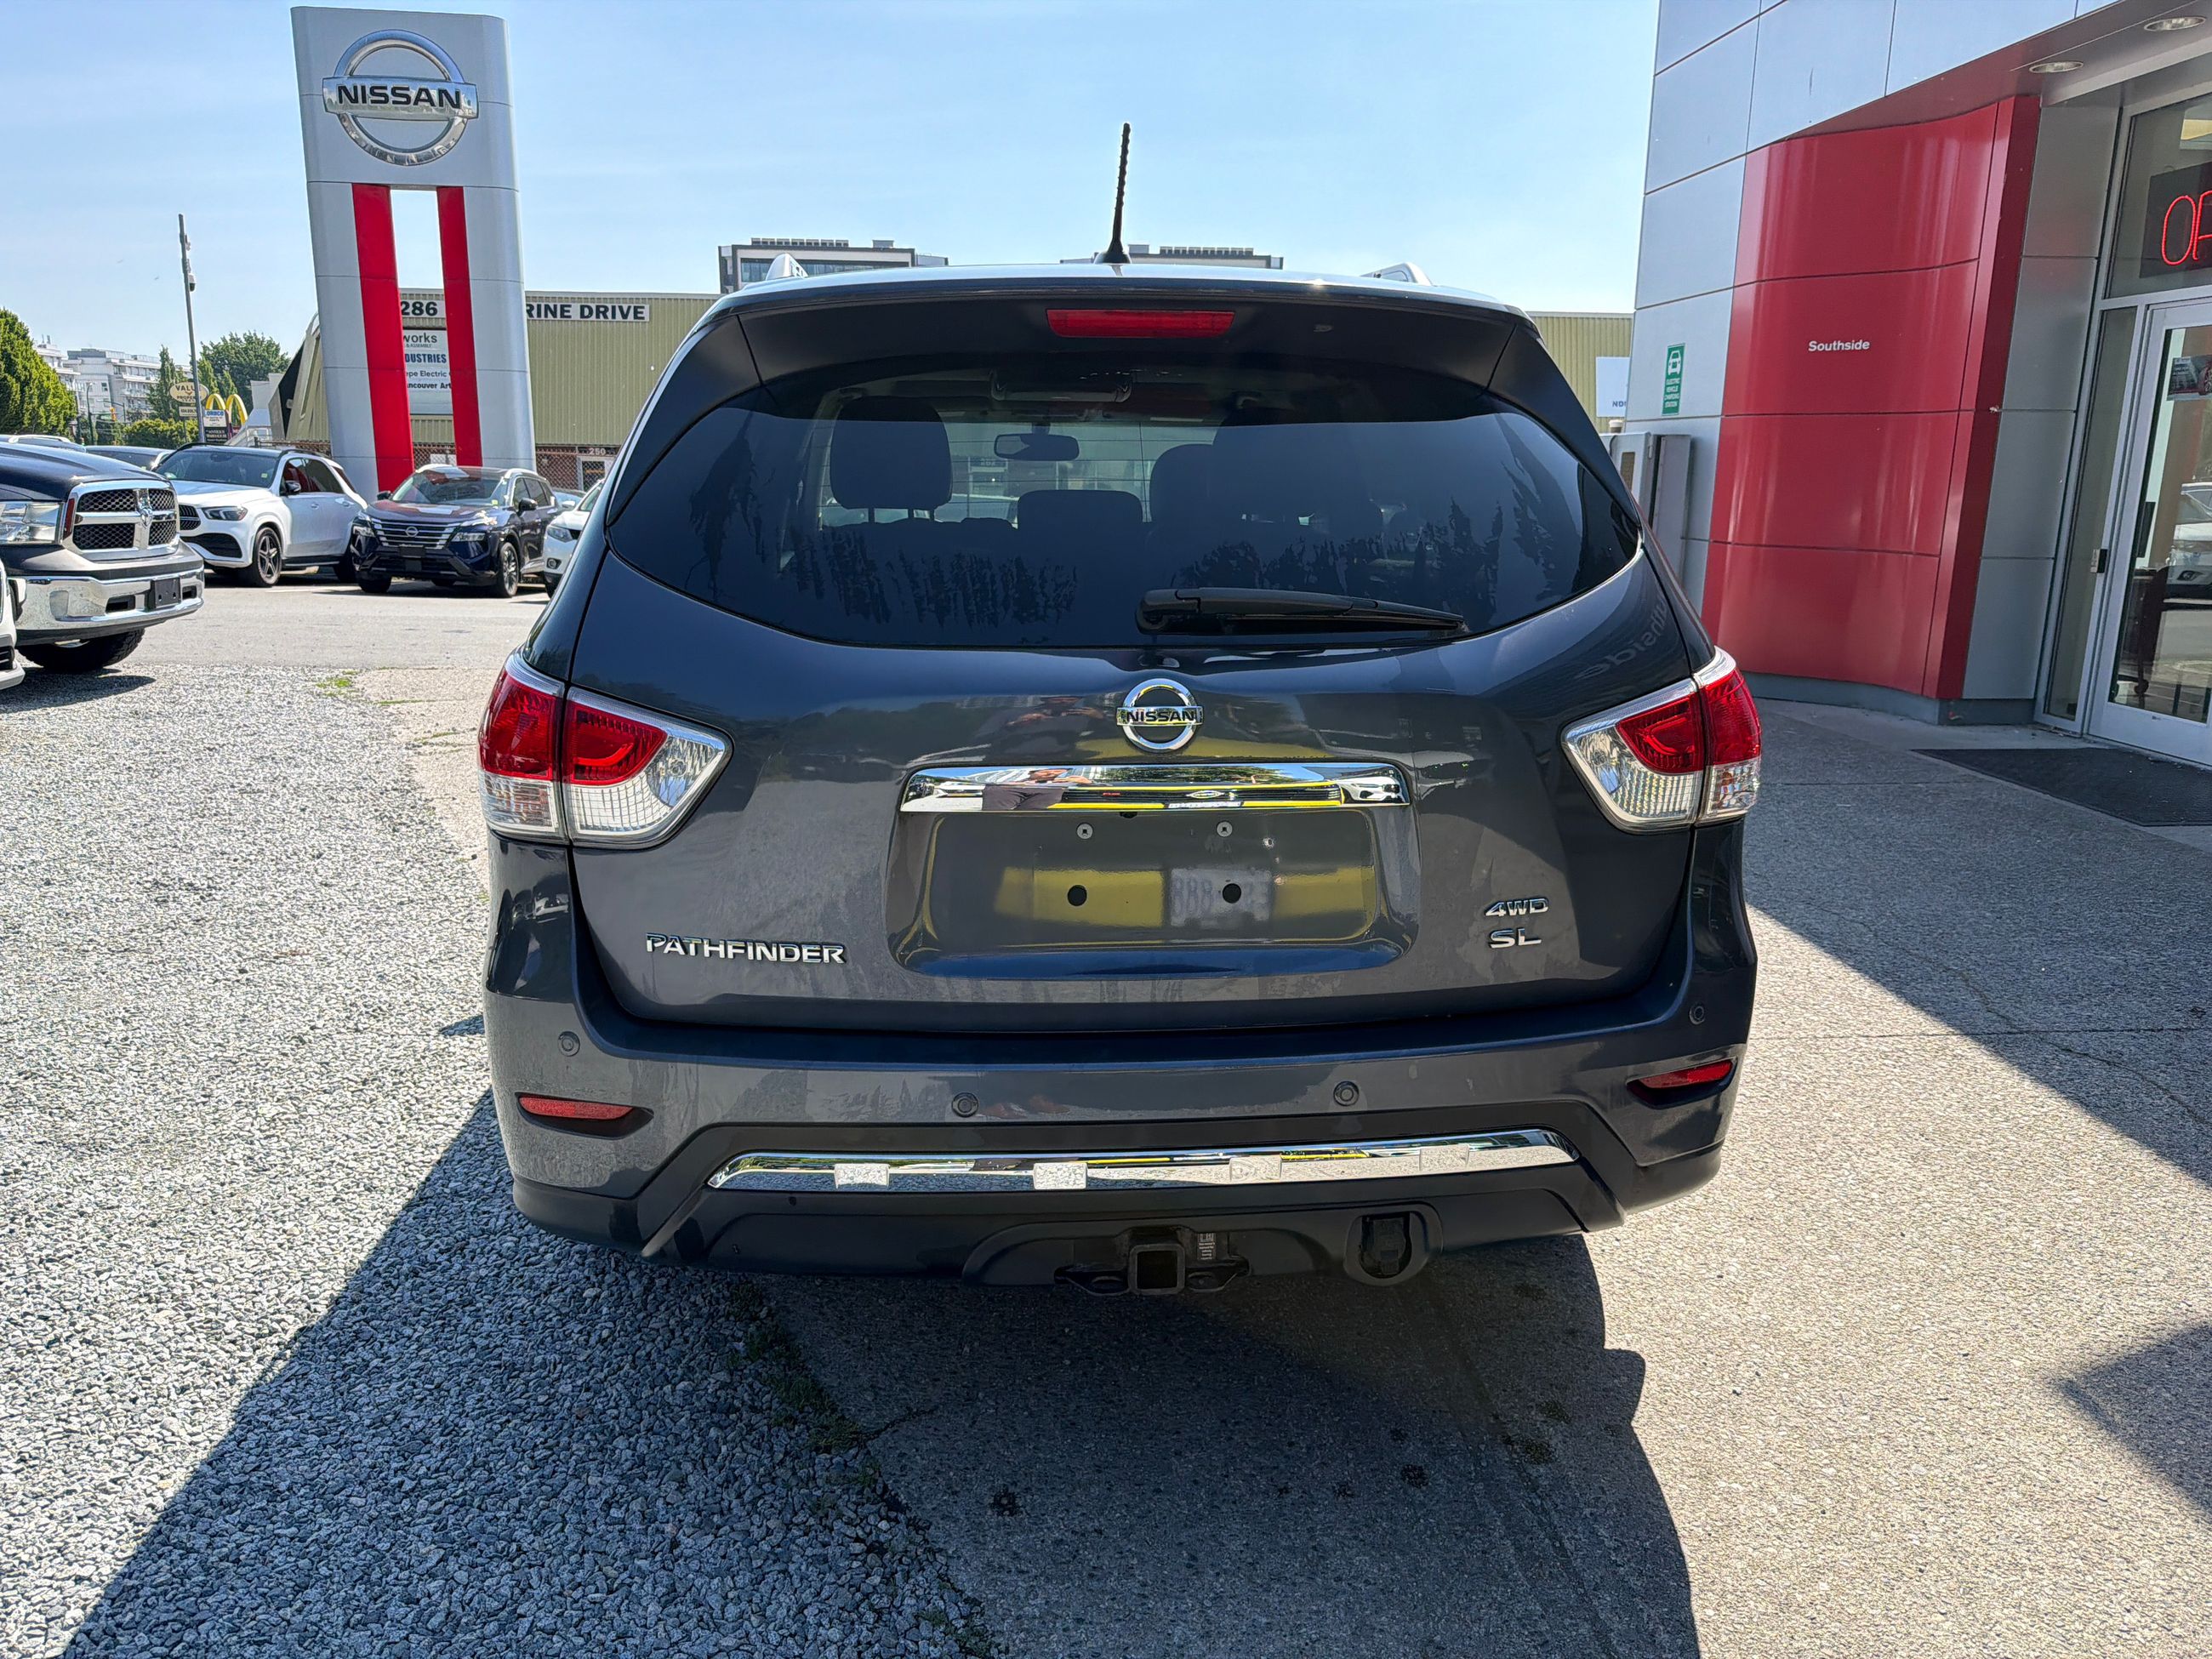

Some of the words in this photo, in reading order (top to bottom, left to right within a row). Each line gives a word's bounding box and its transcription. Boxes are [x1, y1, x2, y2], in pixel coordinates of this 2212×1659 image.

[337, 85, 461, 109] NISSAN
[401, 301, 438, 316] 286
[526, 303, 572, 319] RINE
[579, 304, 645, 320] DRIVE
[1808, 339, 1870, 351] Southside
[589, 448, 606, 456] 250
[1126, 710, 1194, 722] NISSAN
[1485, 897, 1549, 917] 4WD
[1489, 927, 1542, 949] SL
[646, 932, 847, 964] PATHFINDER
